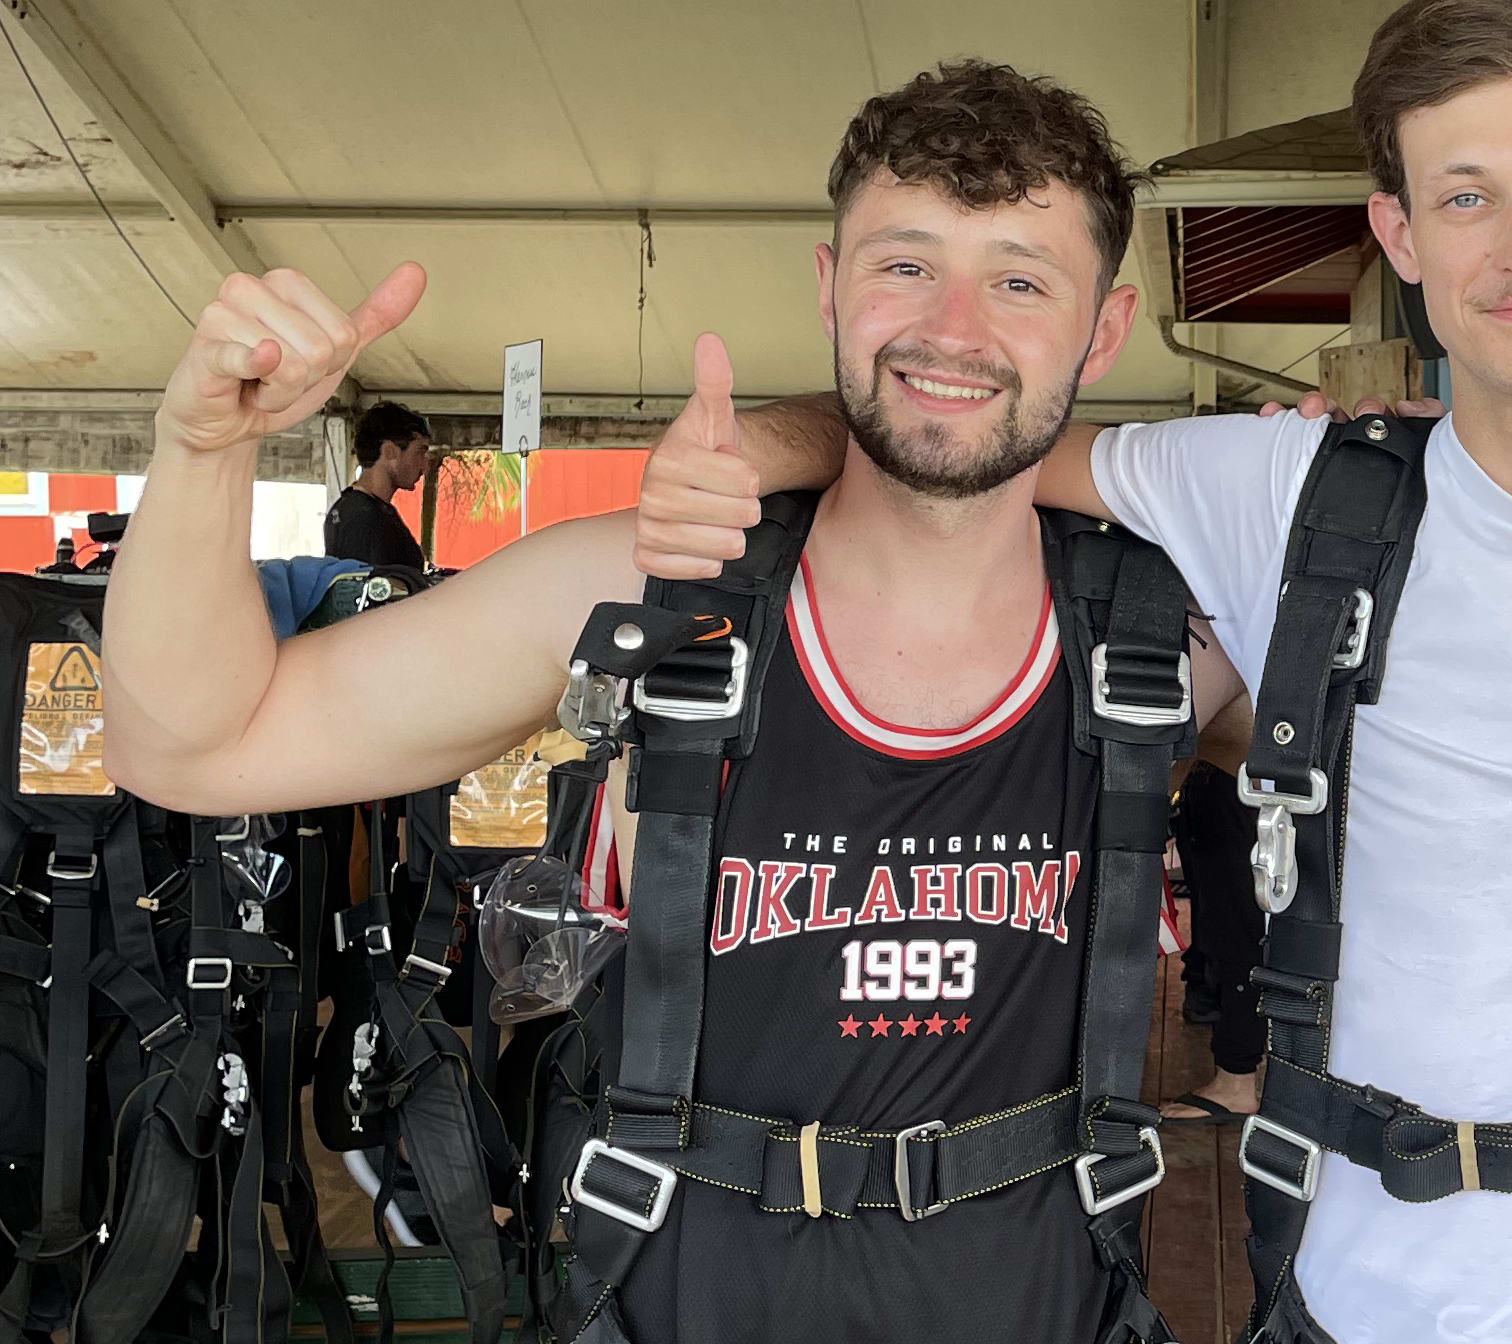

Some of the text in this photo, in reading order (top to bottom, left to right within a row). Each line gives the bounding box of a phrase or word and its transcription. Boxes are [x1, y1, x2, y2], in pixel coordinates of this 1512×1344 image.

[24, 694, 97, 709] DANGER
[783, 832, 1054, 855] THE ORIGINAL
[839, 939, 978, 1001] 1993
